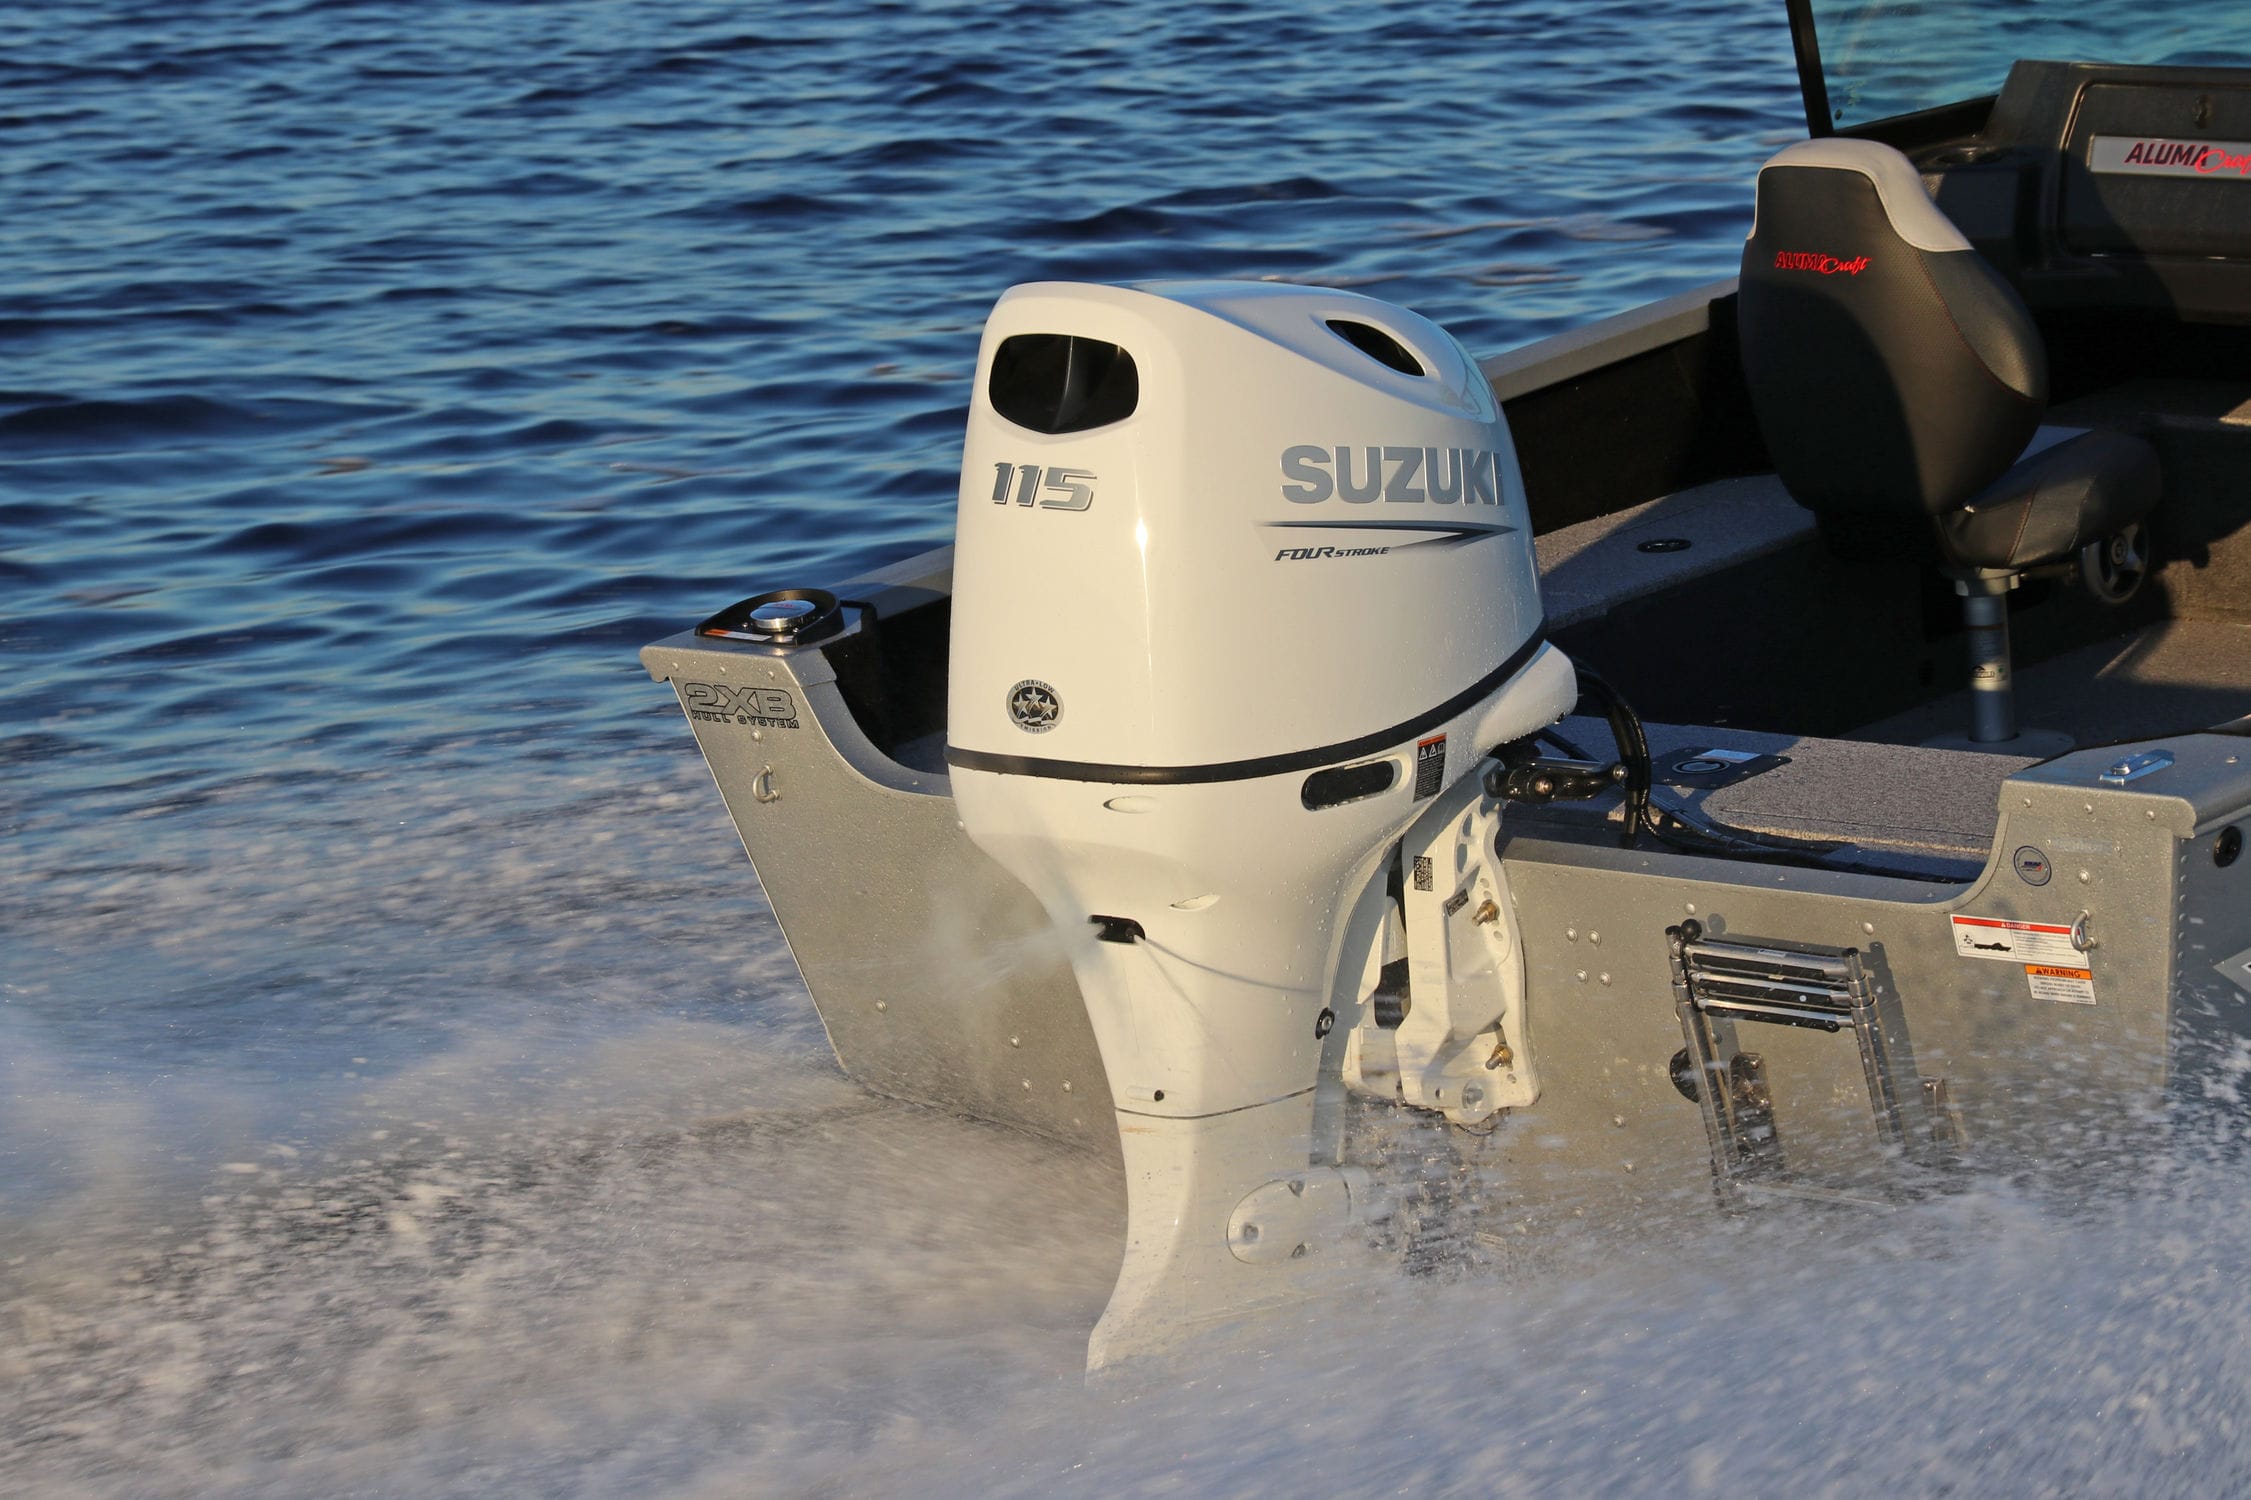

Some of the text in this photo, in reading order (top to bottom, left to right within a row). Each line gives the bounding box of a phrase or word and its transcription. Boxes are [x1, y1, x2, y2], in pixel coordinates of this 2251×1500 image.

[992, 462, 1097, 511] 115
[1280, 445, 1505, 506] SUZUKI
[684, 682, 797, 720] 2XB
[692, 711, 799, 729] HULL SYSTEM
[2041, 967, 2081, 977] WARNING
